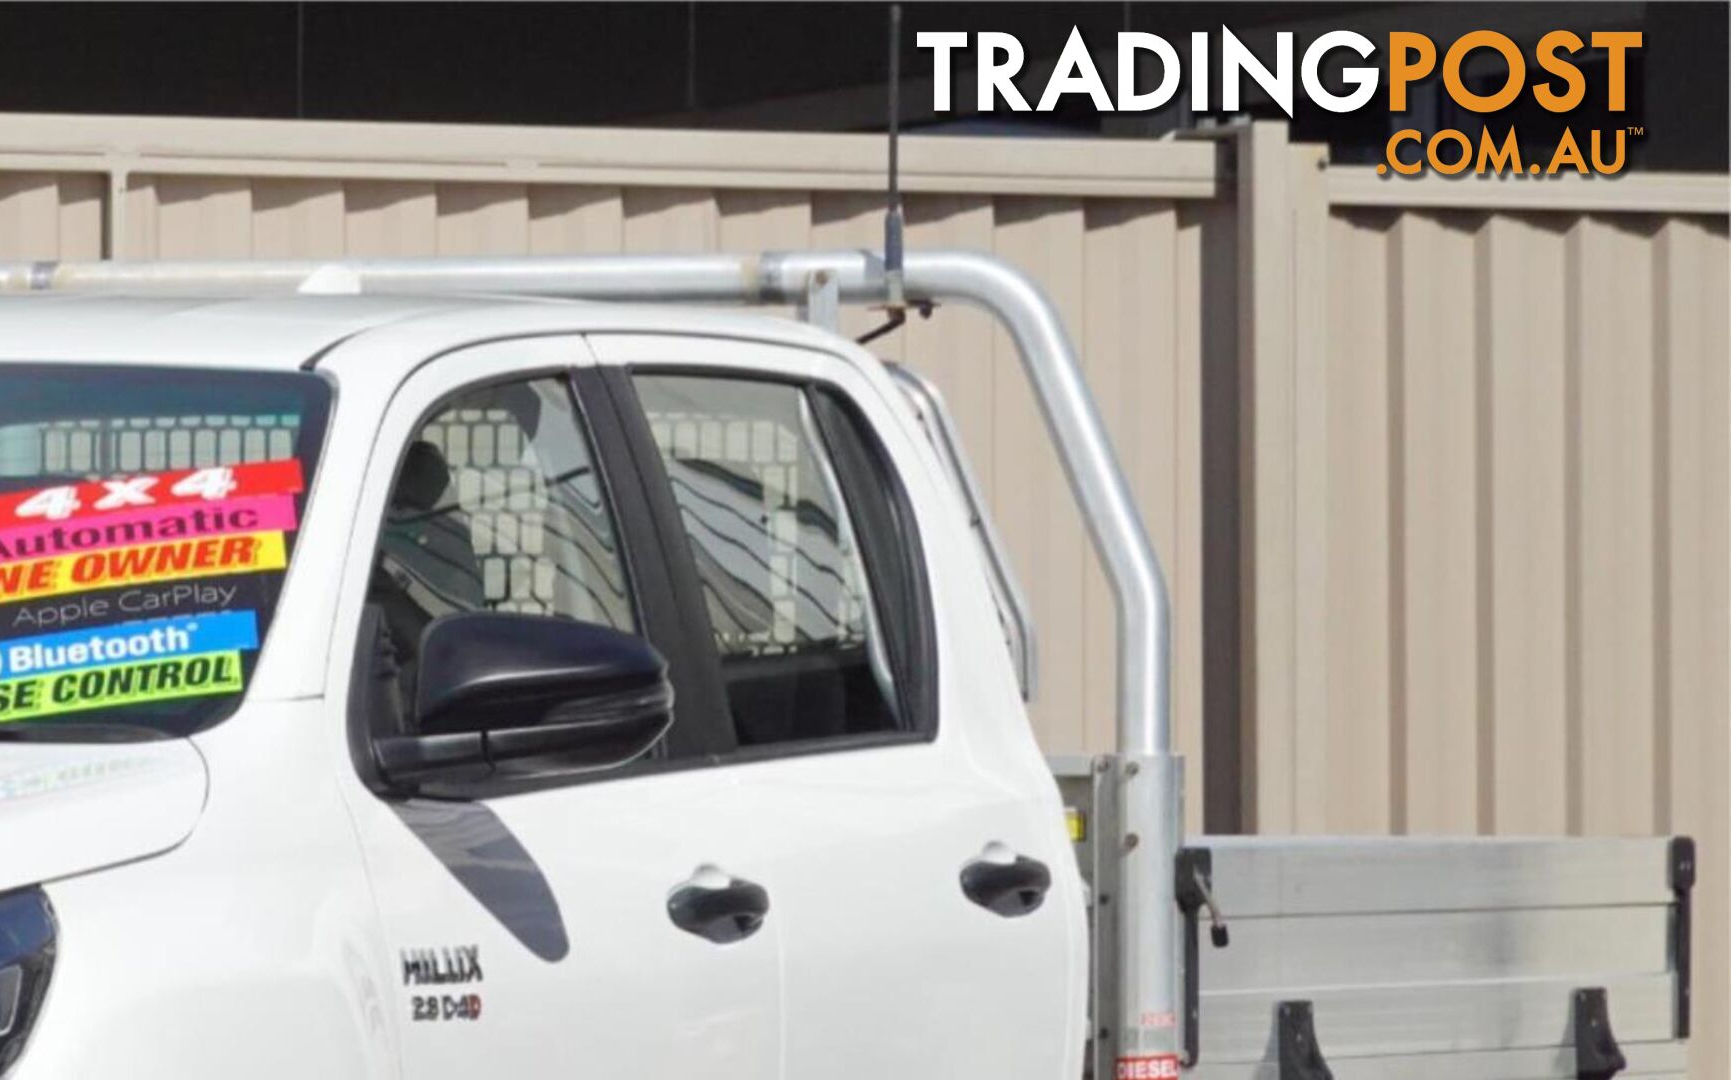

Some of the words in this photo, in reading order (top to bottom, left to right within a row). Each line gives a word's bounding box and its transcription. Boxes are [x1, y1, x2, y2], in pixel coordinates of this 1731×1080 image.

[70, 535, 262, 585] OWNER
[12, 595, 110, 629] Apple
[119, 584, 237, 613] CarPlay
[51, 654, 233, 703] CONTROL
[400, 944, 483, 986] HILUX
[1117, 1058, 1179, 1080] DIESEL
